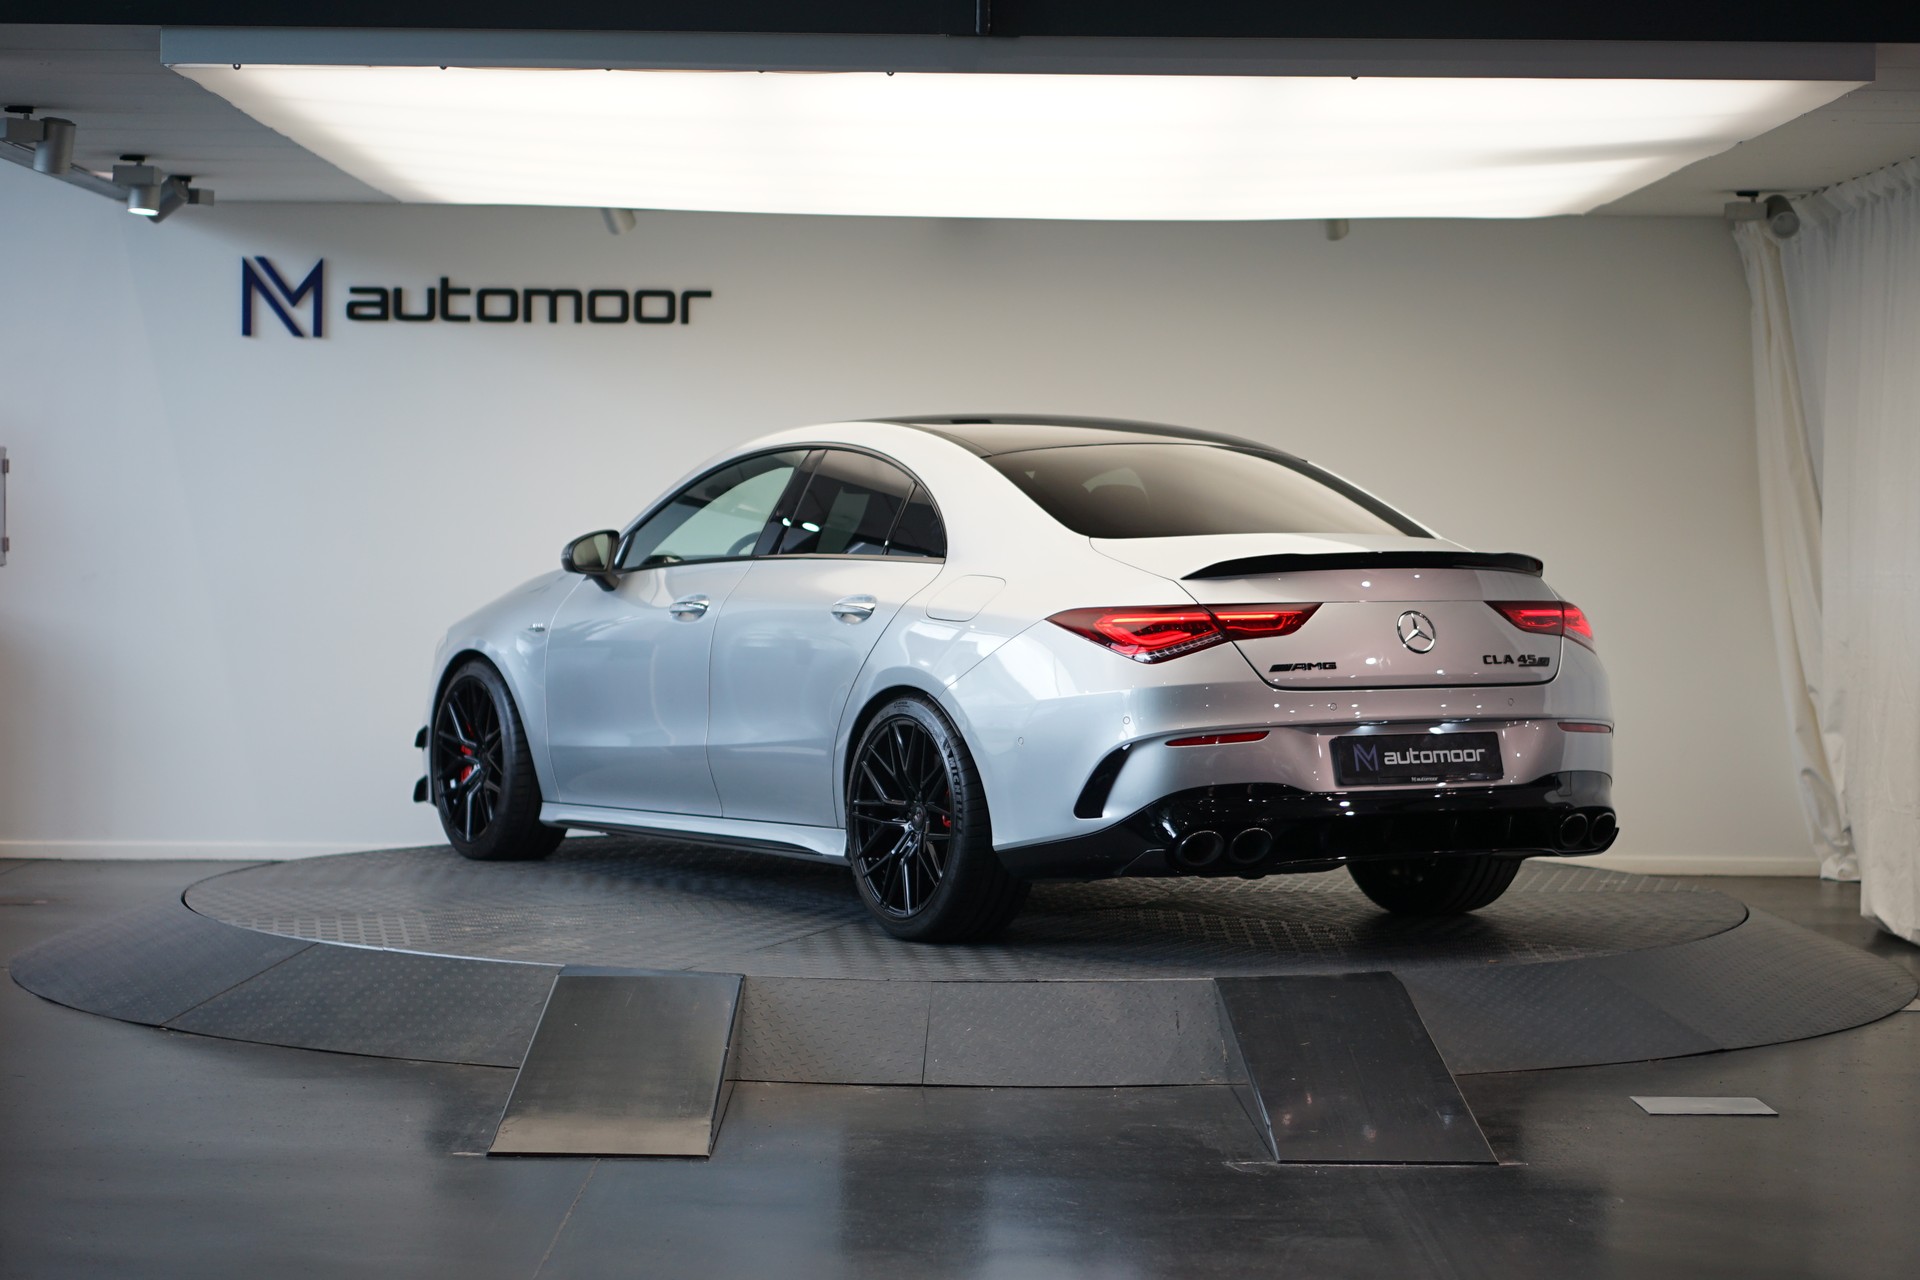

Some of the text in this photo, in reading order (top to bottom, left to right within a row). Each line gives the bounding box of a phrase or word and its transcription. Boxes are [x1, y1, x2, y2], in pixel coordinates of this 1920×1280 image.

[345, 277, 712, 324] automoor
[1291, 662, 1337, 671] AMG
[1482, 654, 1514, 664] CLA
[1384, 748, 1485, 764] automoor
[948, 757, 962, 830] MICHELIN
